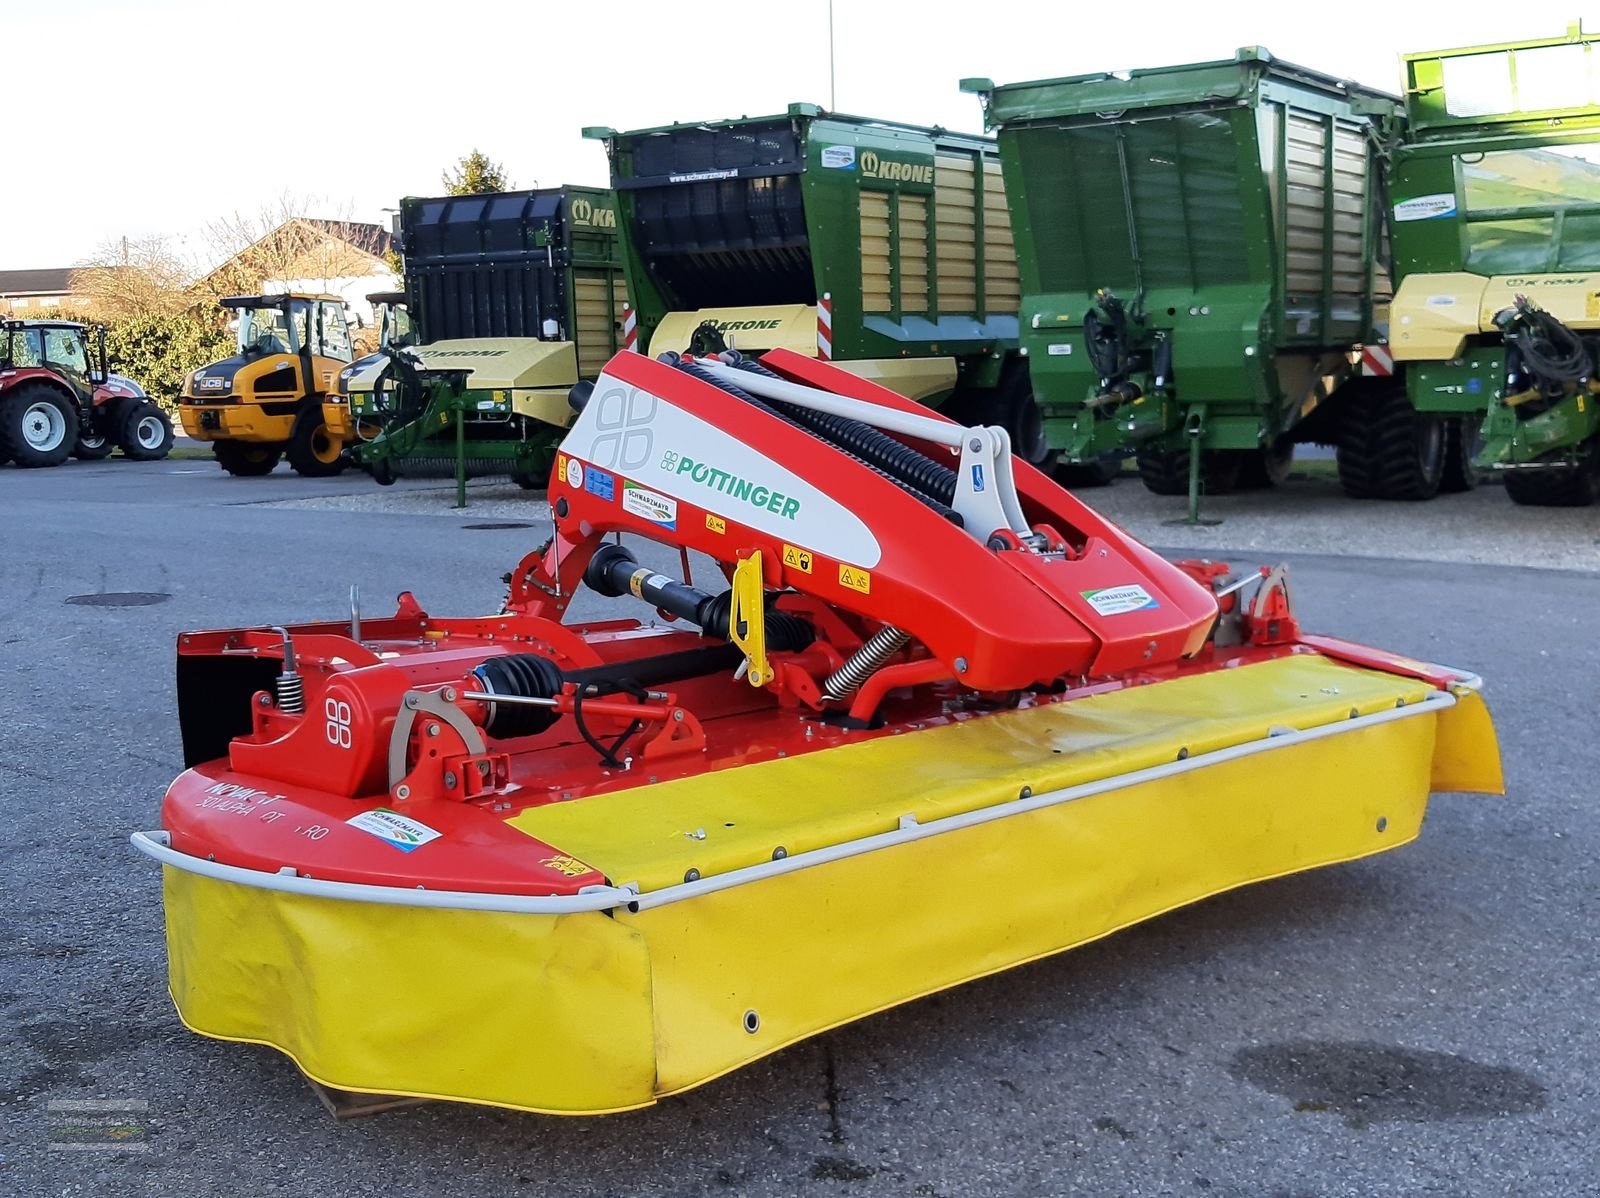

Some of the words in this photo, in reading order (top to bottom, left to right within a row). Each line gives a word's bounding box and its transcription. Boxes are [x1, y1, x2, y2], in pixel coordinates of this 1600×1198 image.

[879, 161, 933, 184] KRONE
[717, 319, 782, 331] KRONE
[201, 379, 222, 388] JCB
[628, 489, 669, 512] SCHWARZMAYR
[370, 810, 424, 838] SCHWARZMAYR
